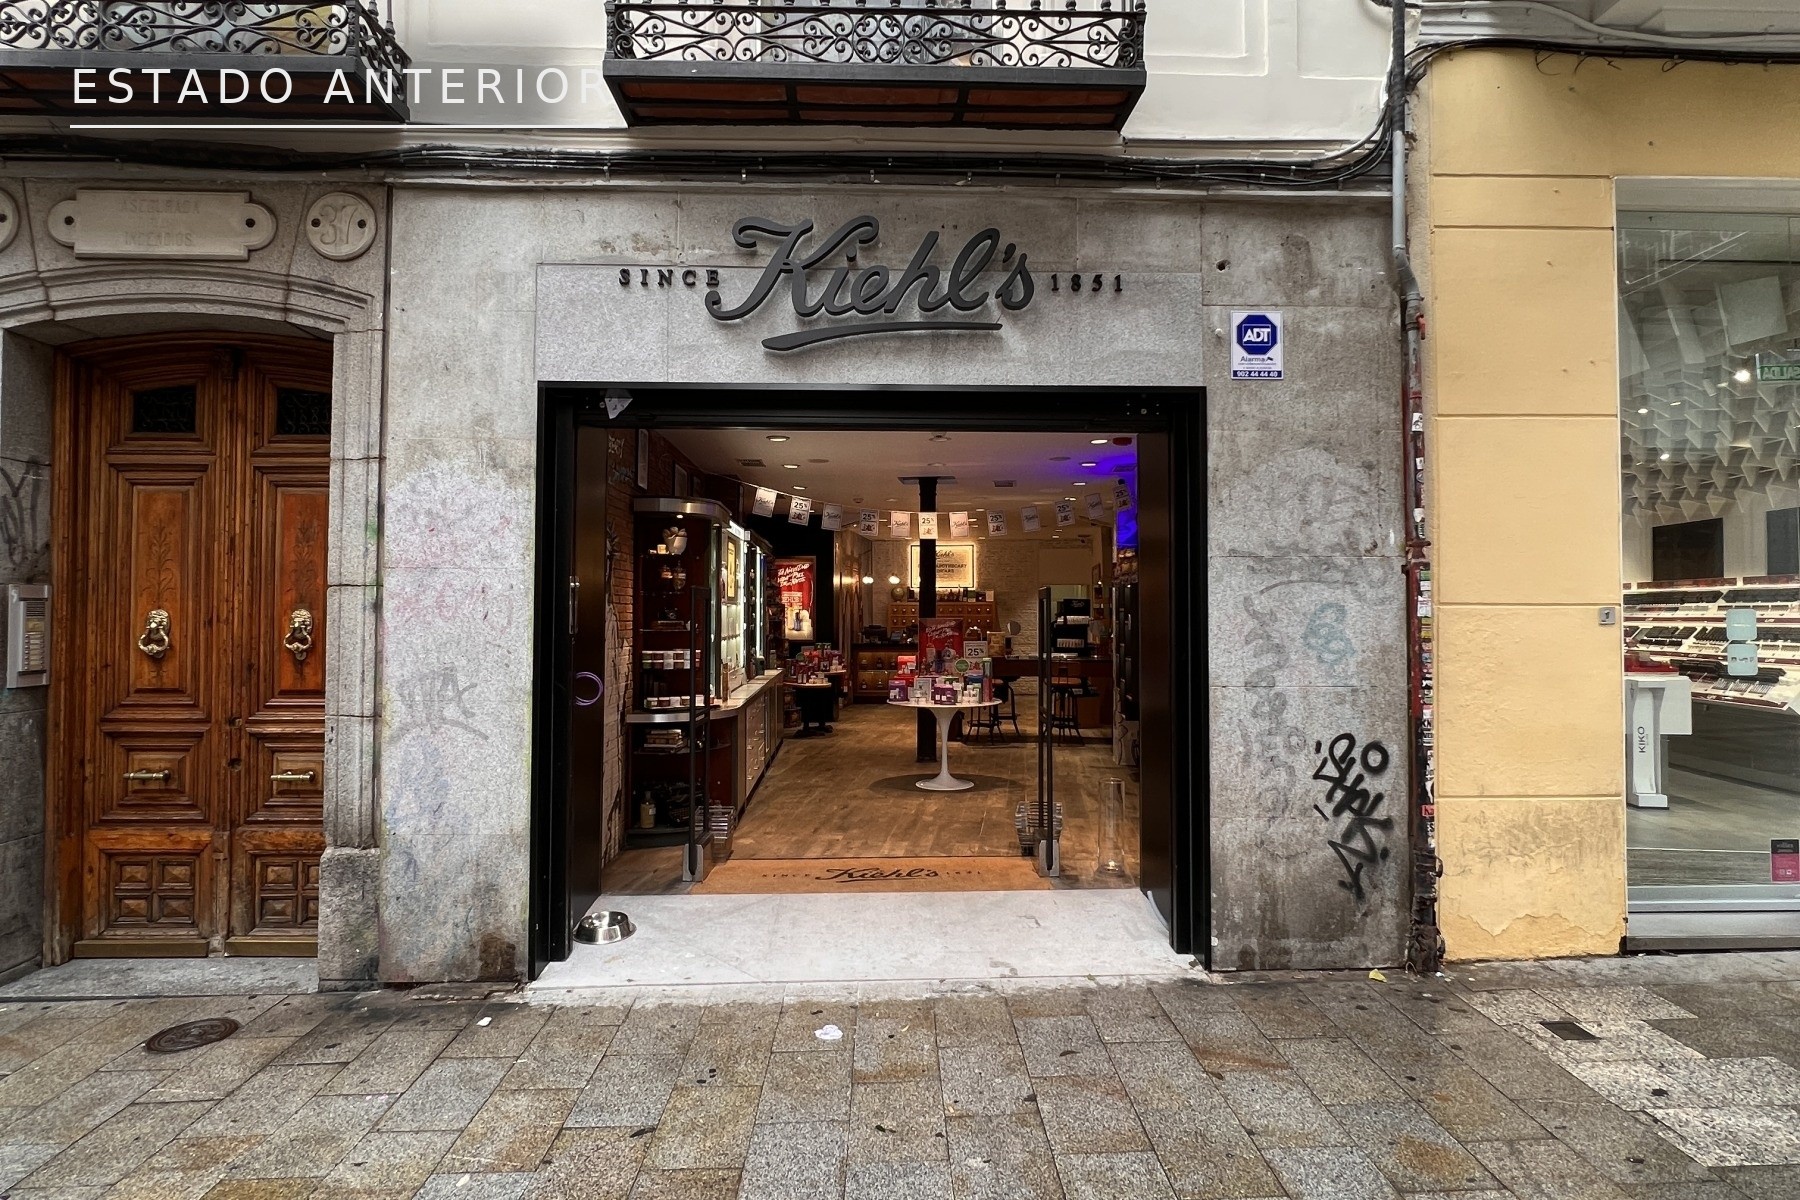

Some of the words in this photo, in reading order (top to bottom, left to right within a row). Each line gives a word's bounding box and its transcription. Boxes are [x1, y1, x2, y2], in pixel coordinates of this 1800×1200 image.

[319, 204, 359, 246] 37
[618, 267, 722, 288] SINCE
[703, 214, 1035, 322] Kiehl's
[1050, 272, 1125, 293] 1851
[1243, 327, 1271, 342] ADT
[1637, 726, 1646, 753] KIKO
[815, 868, 939, 880] Kiehl's
